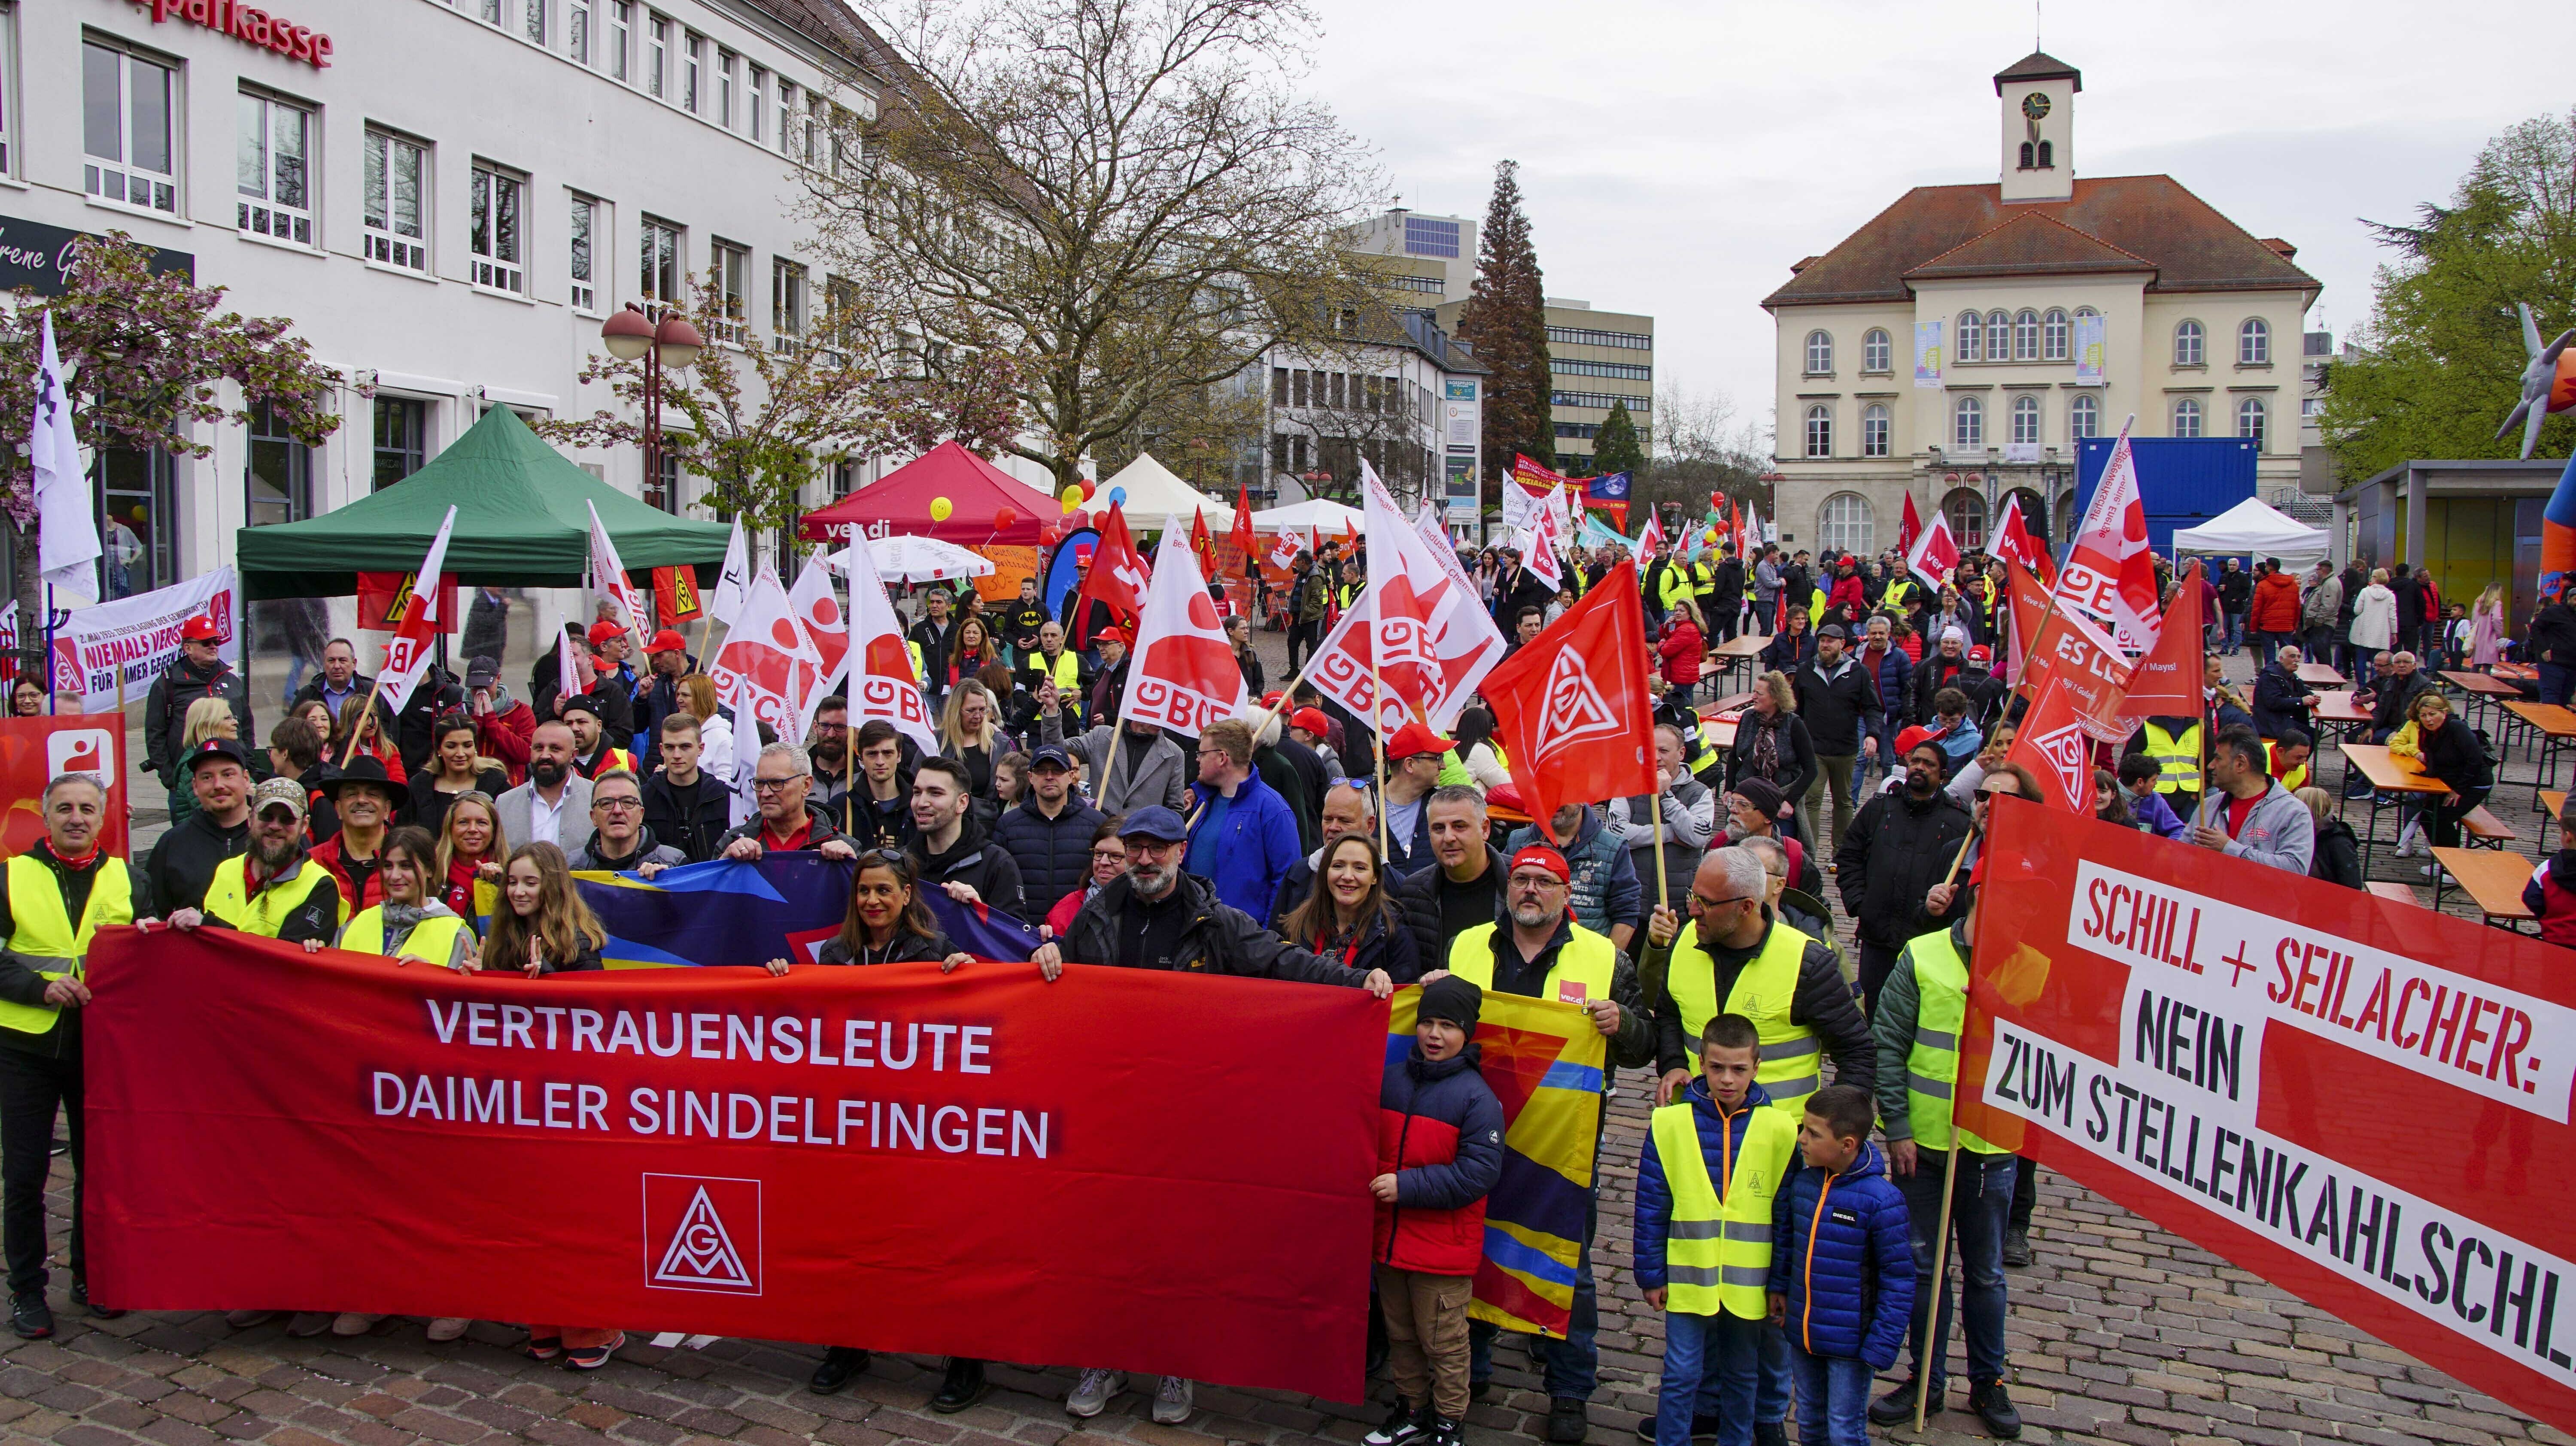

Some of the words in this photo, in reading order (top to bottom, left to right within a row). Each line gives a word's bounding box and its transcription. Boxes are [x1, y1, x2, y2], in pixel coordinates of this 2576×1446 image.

[127, 0, 333, 68] parkasse
[0, 227, 45, 270] rene
[1448, 568, 1476, 601] Chemie,
[87, 631, 100, 643] MAI
[115, 618, 157, 637] ZERSCHLAGUNG
[157, 614, 168, 626] DER
[84, 637, 149, 670] NIEMALS
[2054, 632, 2089, 666] ES
[91, 672, 113, 694] FÜR
[1132, 681, 1167, 719] IG
[1522, 857, 1546, 865] ver.di
[1560, 993, 1585, 1005] ver.di
[2083, 876, 2204, 976] SCHILL
[2267, 936, 2542, 1095] SEILACHER:
[425, 998, 993, 1076] VERTRAUENSLEUTE
[2135, 989, 2243, 1101] NEIN
[374, 1070, 611, 1132] DAIMLER
[628, 1086, 1049, 1160] SINDELFINGEN
[1832, 1212, 1856, 1222] DIESEL
[1994, 1033, 2076, 1128] ZUM
[2085, 1074, 2576, 1371] STELLENKAHLSCHL
